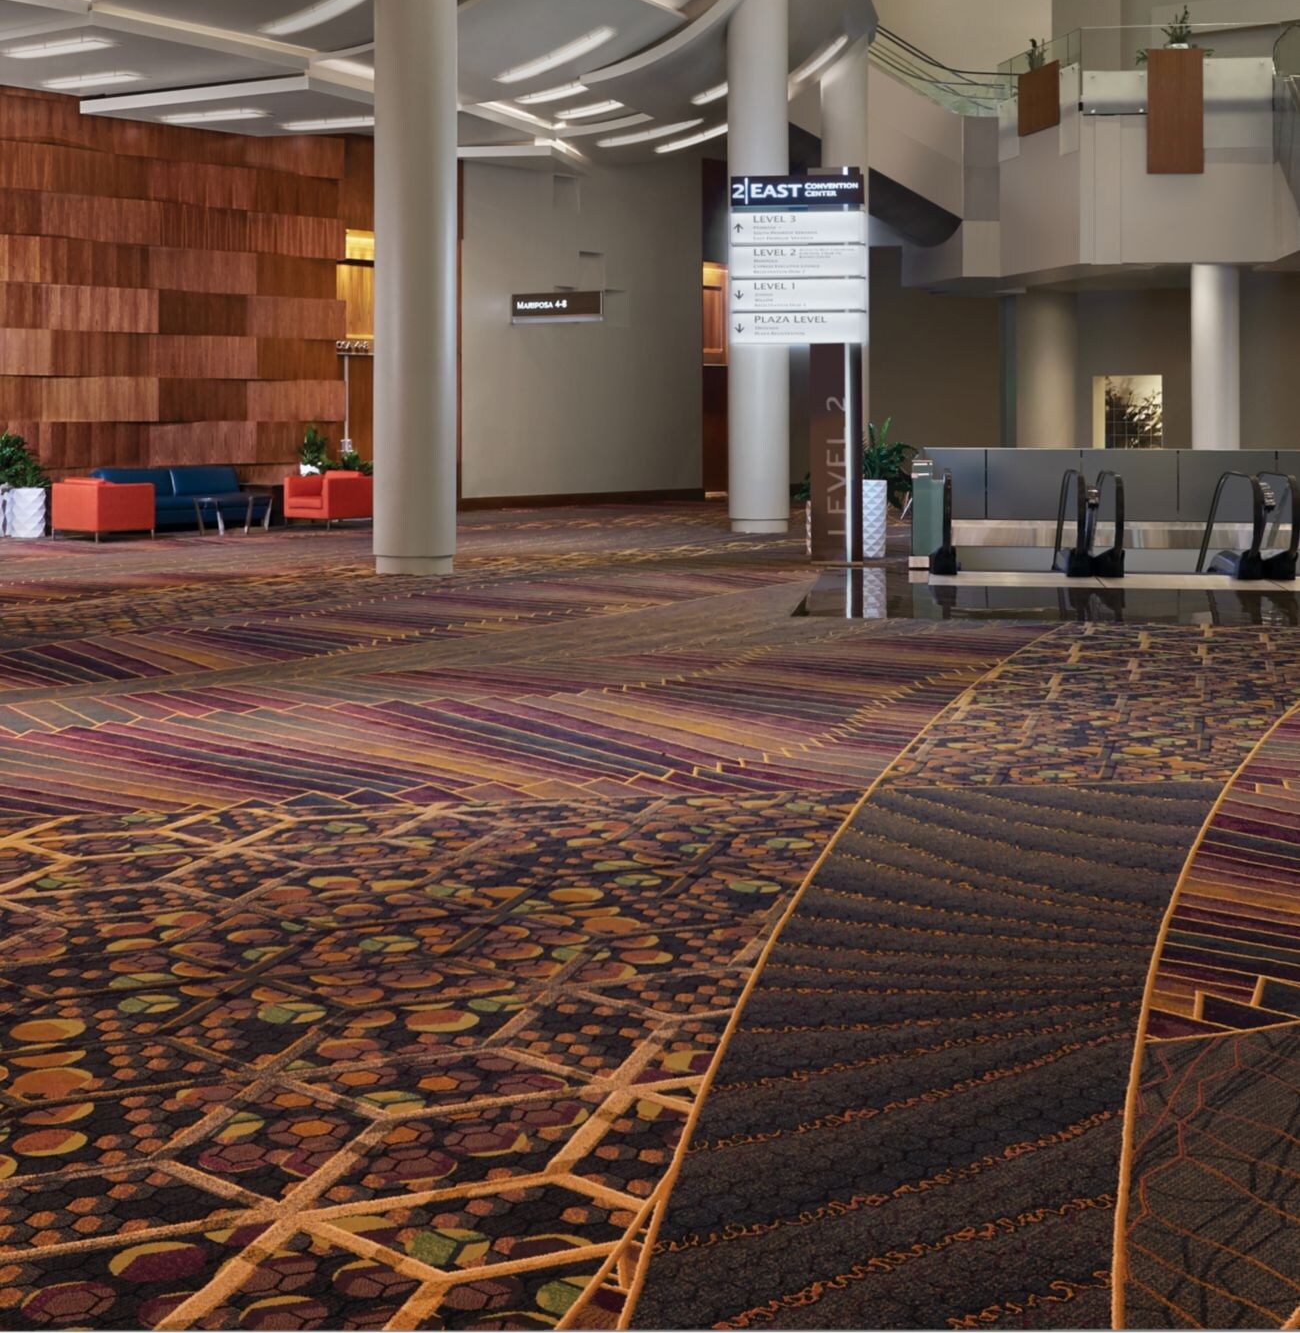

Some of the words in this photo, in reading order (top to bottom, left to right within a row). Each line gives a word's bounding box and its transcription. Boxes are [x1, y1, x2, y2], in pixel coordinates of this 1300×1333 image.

[804, 182, 859, 190] CONVENTION
[732, 184, 745, 199] 2
[750, 183, 803, 198] EAST
[753, 215, 786, 223] LEVEL
[790, 215, 796, 223] 3
[753, 249, 786, 257] LEVEL
[790, 249, 796, 257] 2
[753, 282, 787, 290] LEVEL
[791, 282, 796, 290] 1
[516, 301, 553, 310] MARIPOSA
[754, 316, 790, 324] PLAZA
[793, 315, 827, 323] LEVEL
[826, 396, 846, 411] 2
[826, 426, 846, 535] LEVEL
